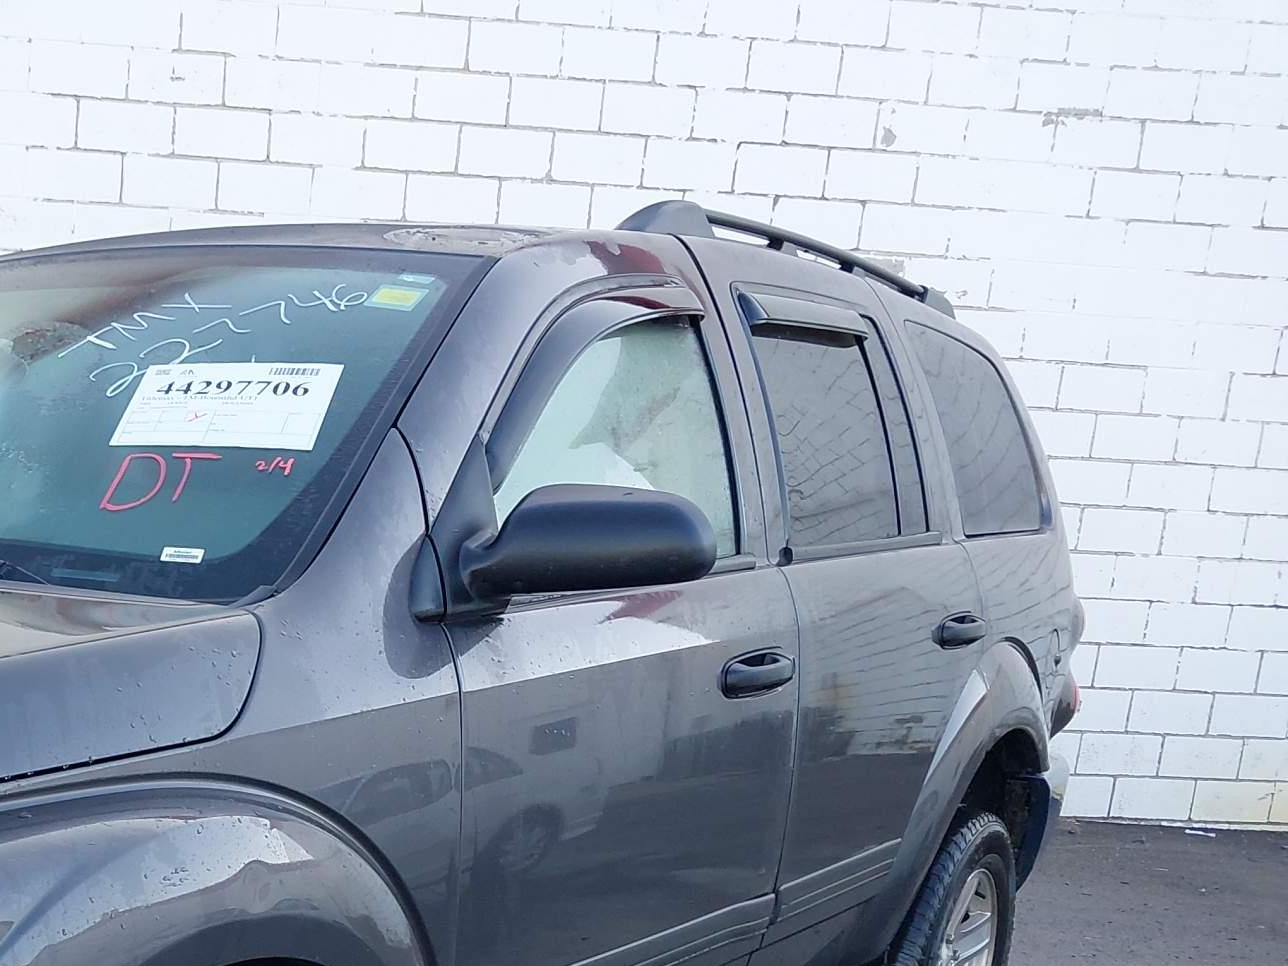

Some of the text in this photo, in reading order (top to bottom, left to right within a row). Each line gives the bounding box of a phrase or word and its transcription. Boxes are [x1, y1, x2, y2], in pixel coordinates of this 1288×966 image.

[156, 380, 313, 397] 44297706
[255, 456, 295, 477] 2/4
[99, 452, 223, 512] DT
